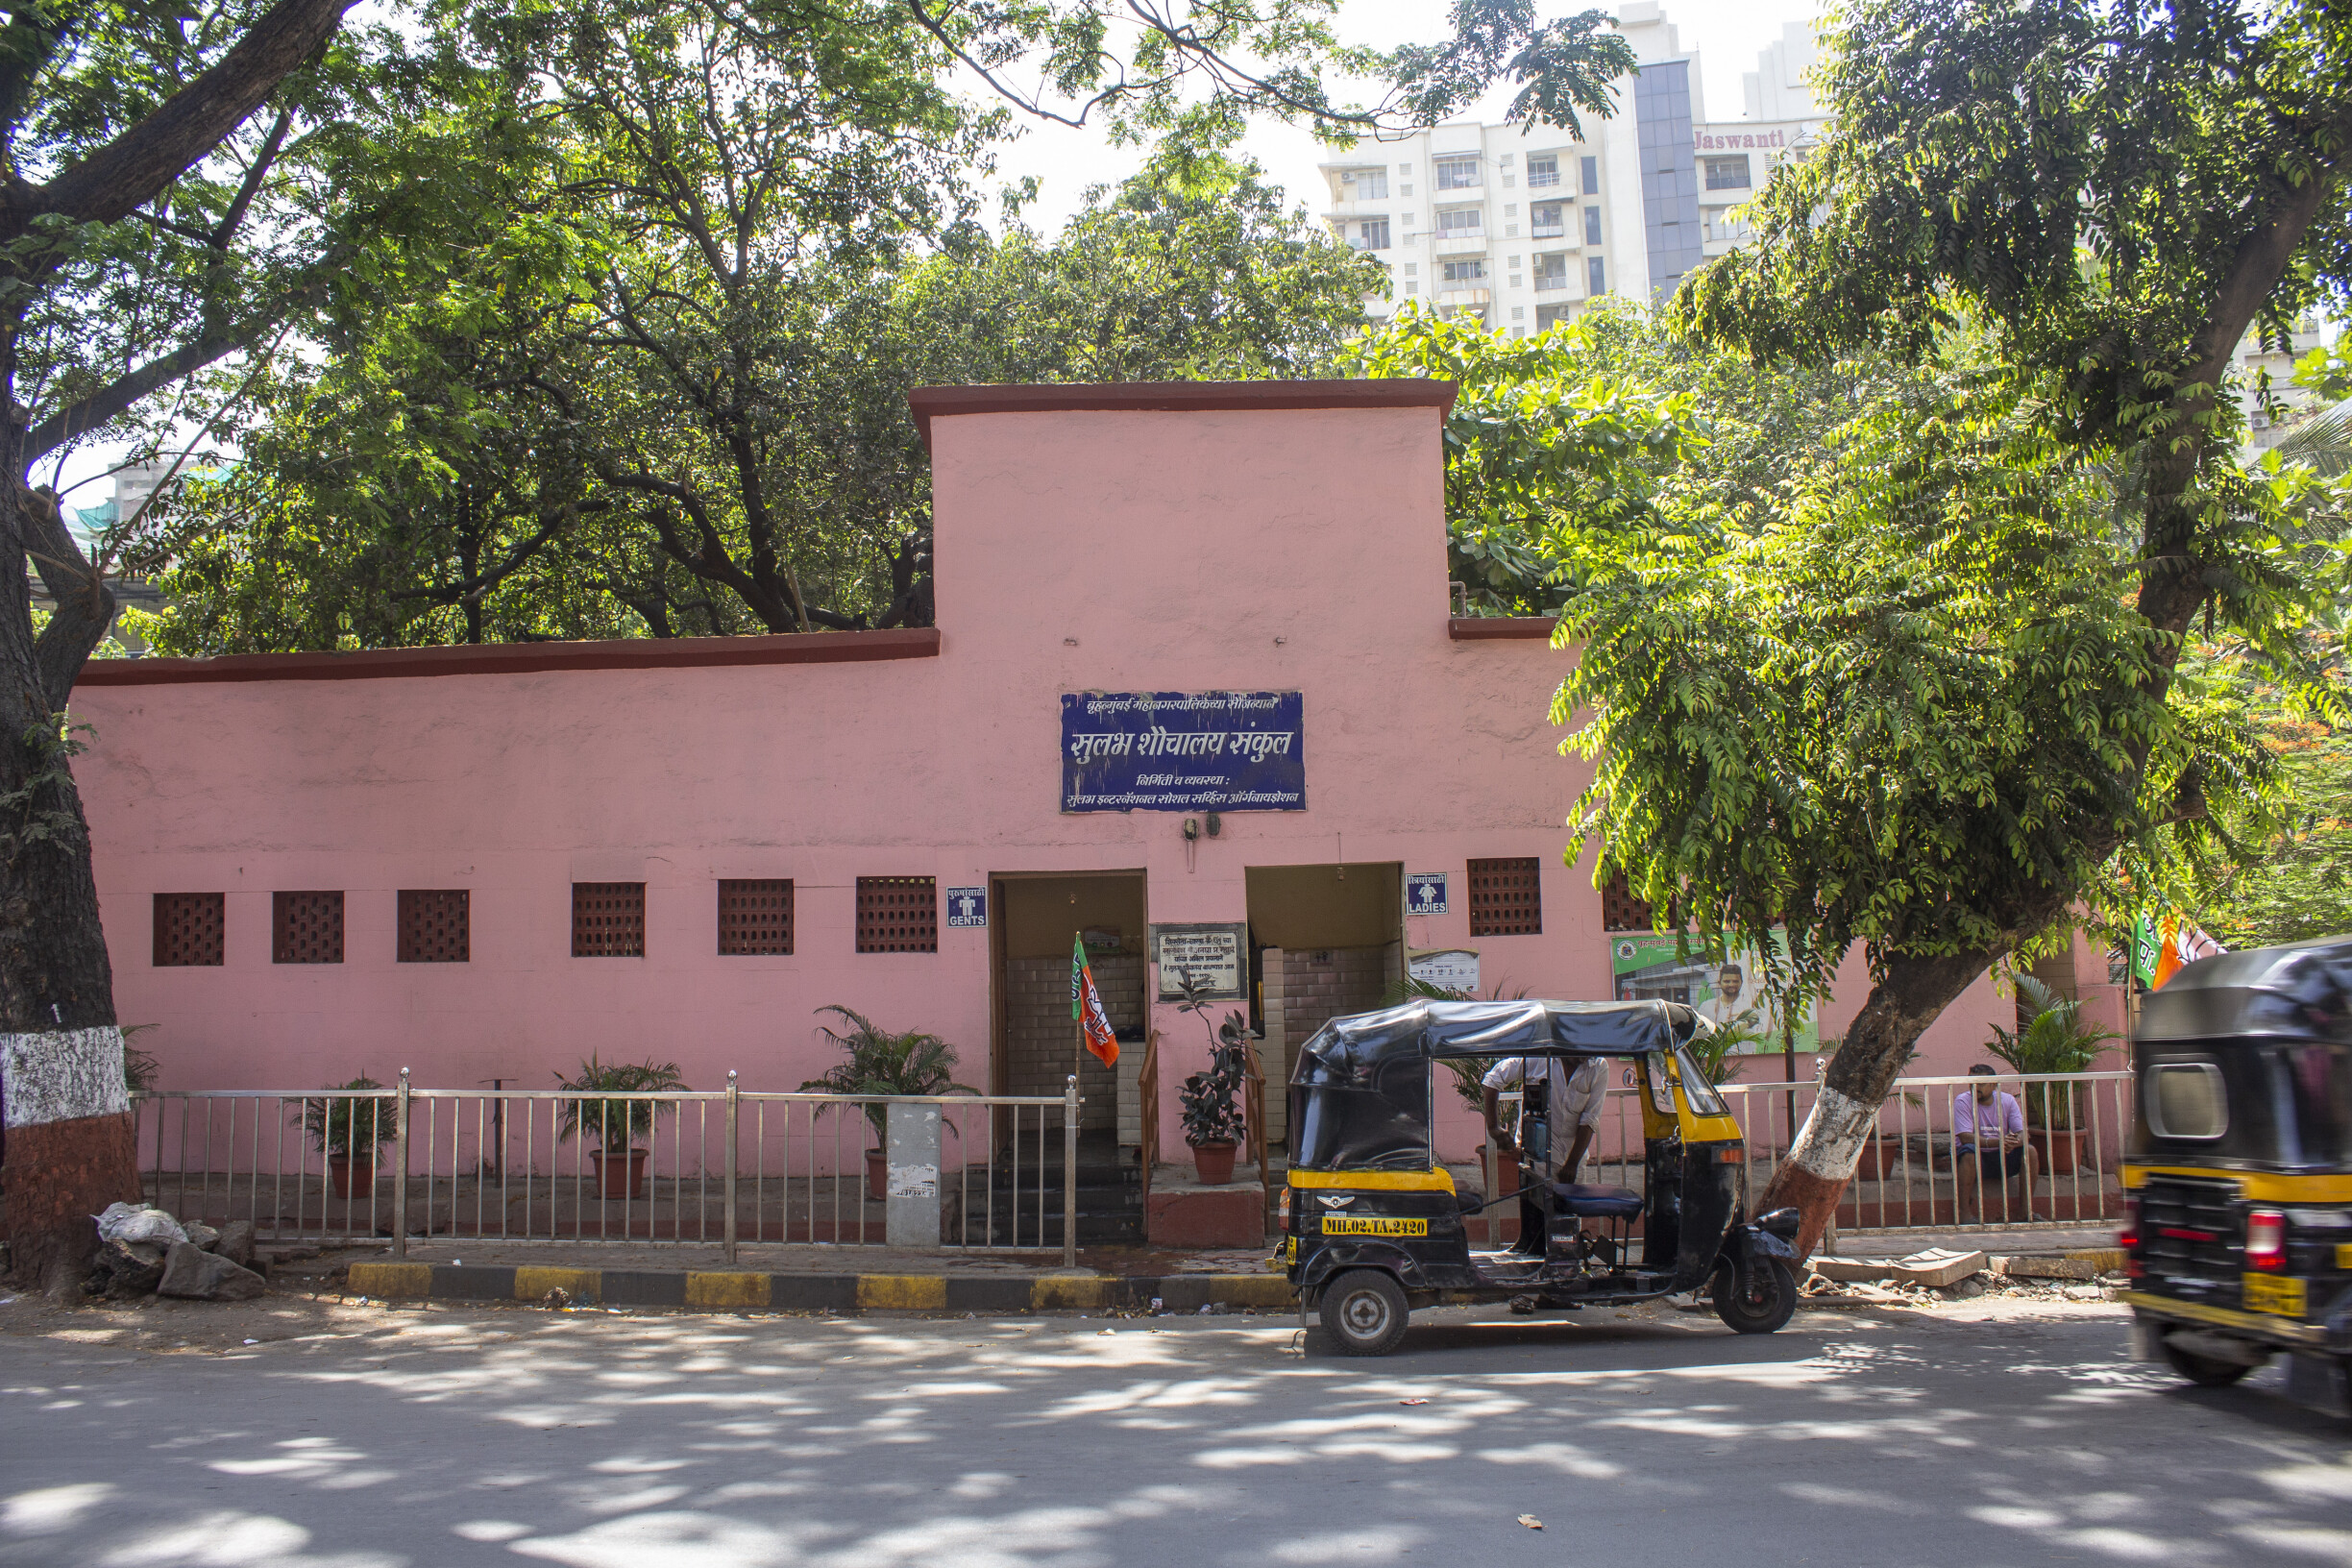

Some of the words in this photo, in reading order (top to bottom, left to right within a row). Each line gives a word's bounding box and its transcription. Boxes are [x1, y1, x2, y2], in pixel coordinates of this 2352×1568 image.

[1694, 130, 1785, 150] Jaswanti
[1070, 733, 1136, 764] सुलभ
[1230, 722, 1294, 763] संकुल
[1136, 773, 1173, 786] निर्मिती
[1174, 775, 1184, 786] व
[1066, 795, 1096, 807] सुलभ
[1158, 792, 1190, 804] सोशल
[1409, 902, 1446, 913] LADIES
[949, 915, 985, 925] GENTS
[1325, 1219, 1425, 1235] MH.02.TA.2420
